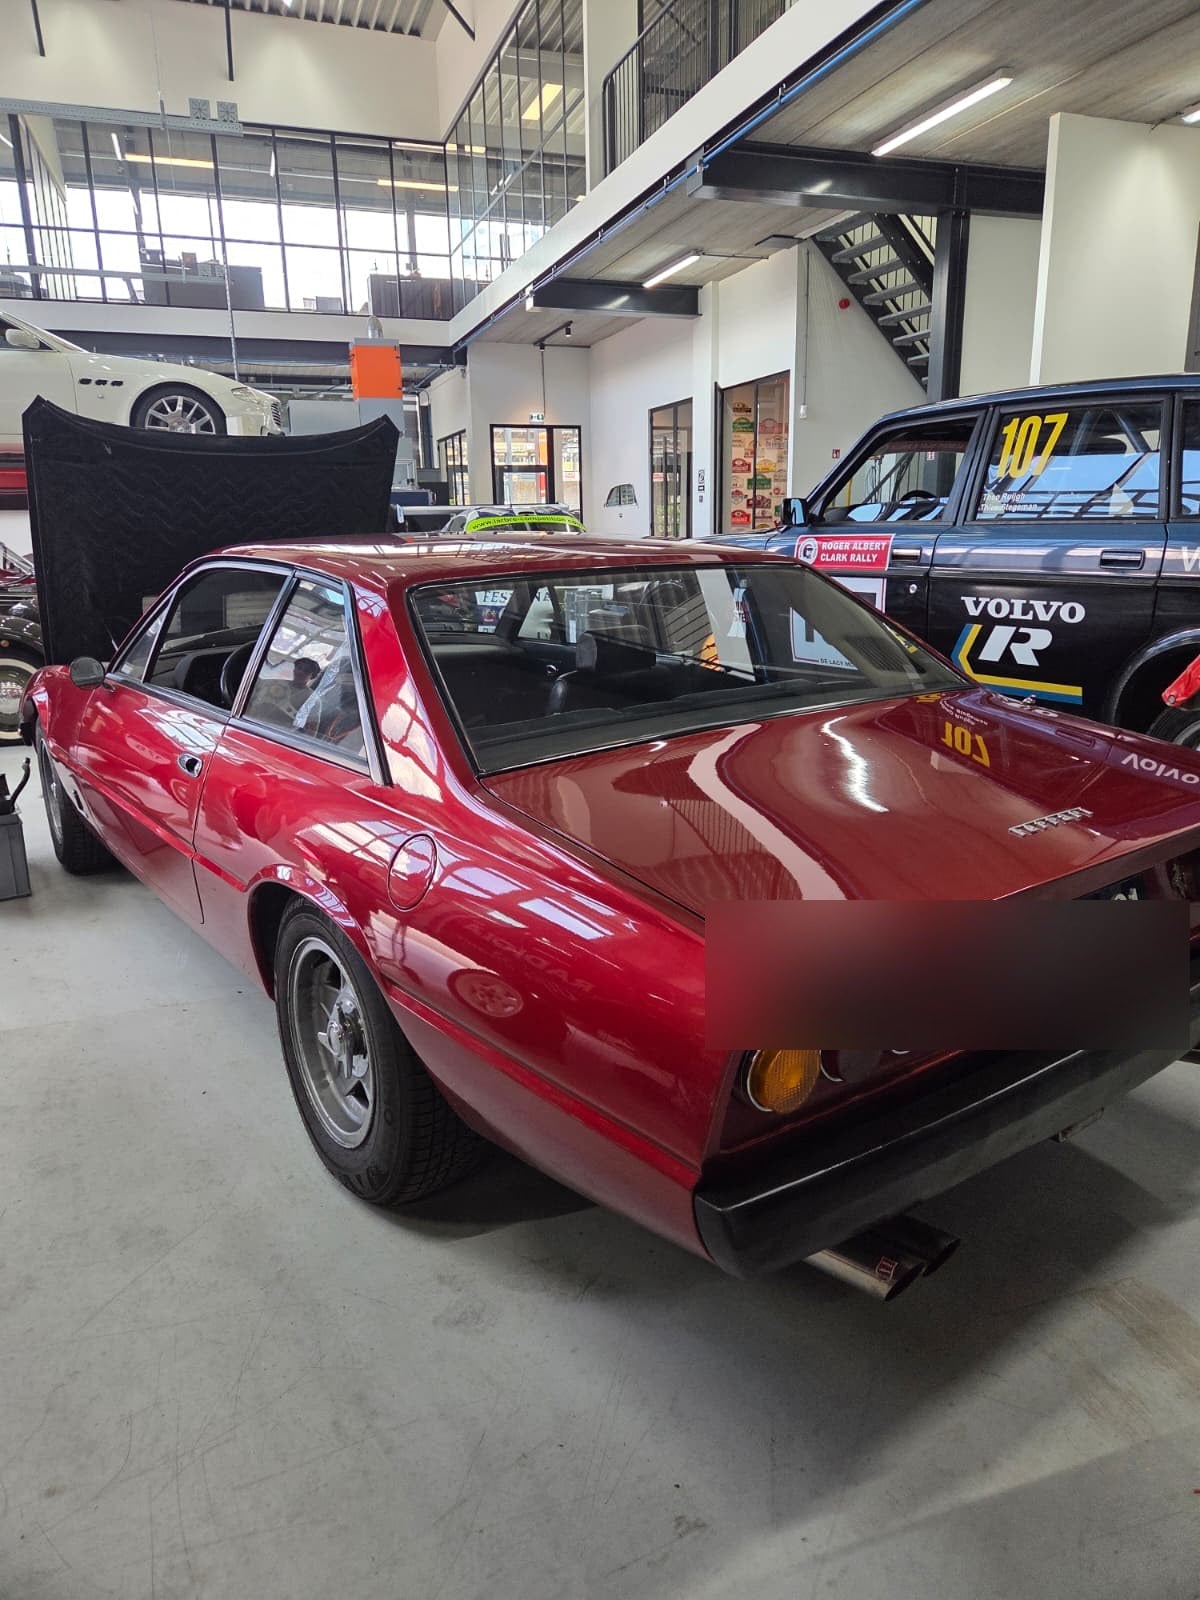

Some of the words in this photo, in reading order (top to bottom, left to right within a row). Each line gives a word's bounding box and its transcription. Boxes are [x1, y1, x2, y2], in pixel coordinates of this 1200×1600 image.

[997, 413, 1068, 478] 107
[822, 542, 850, 551] ROGER
[852, 542, 887, 551] ALBERT
[820, 553, 848, 562] CLARK
[850, 553, 878, 563] RALLY
[961, 596, 1086, 624] VOLVO
